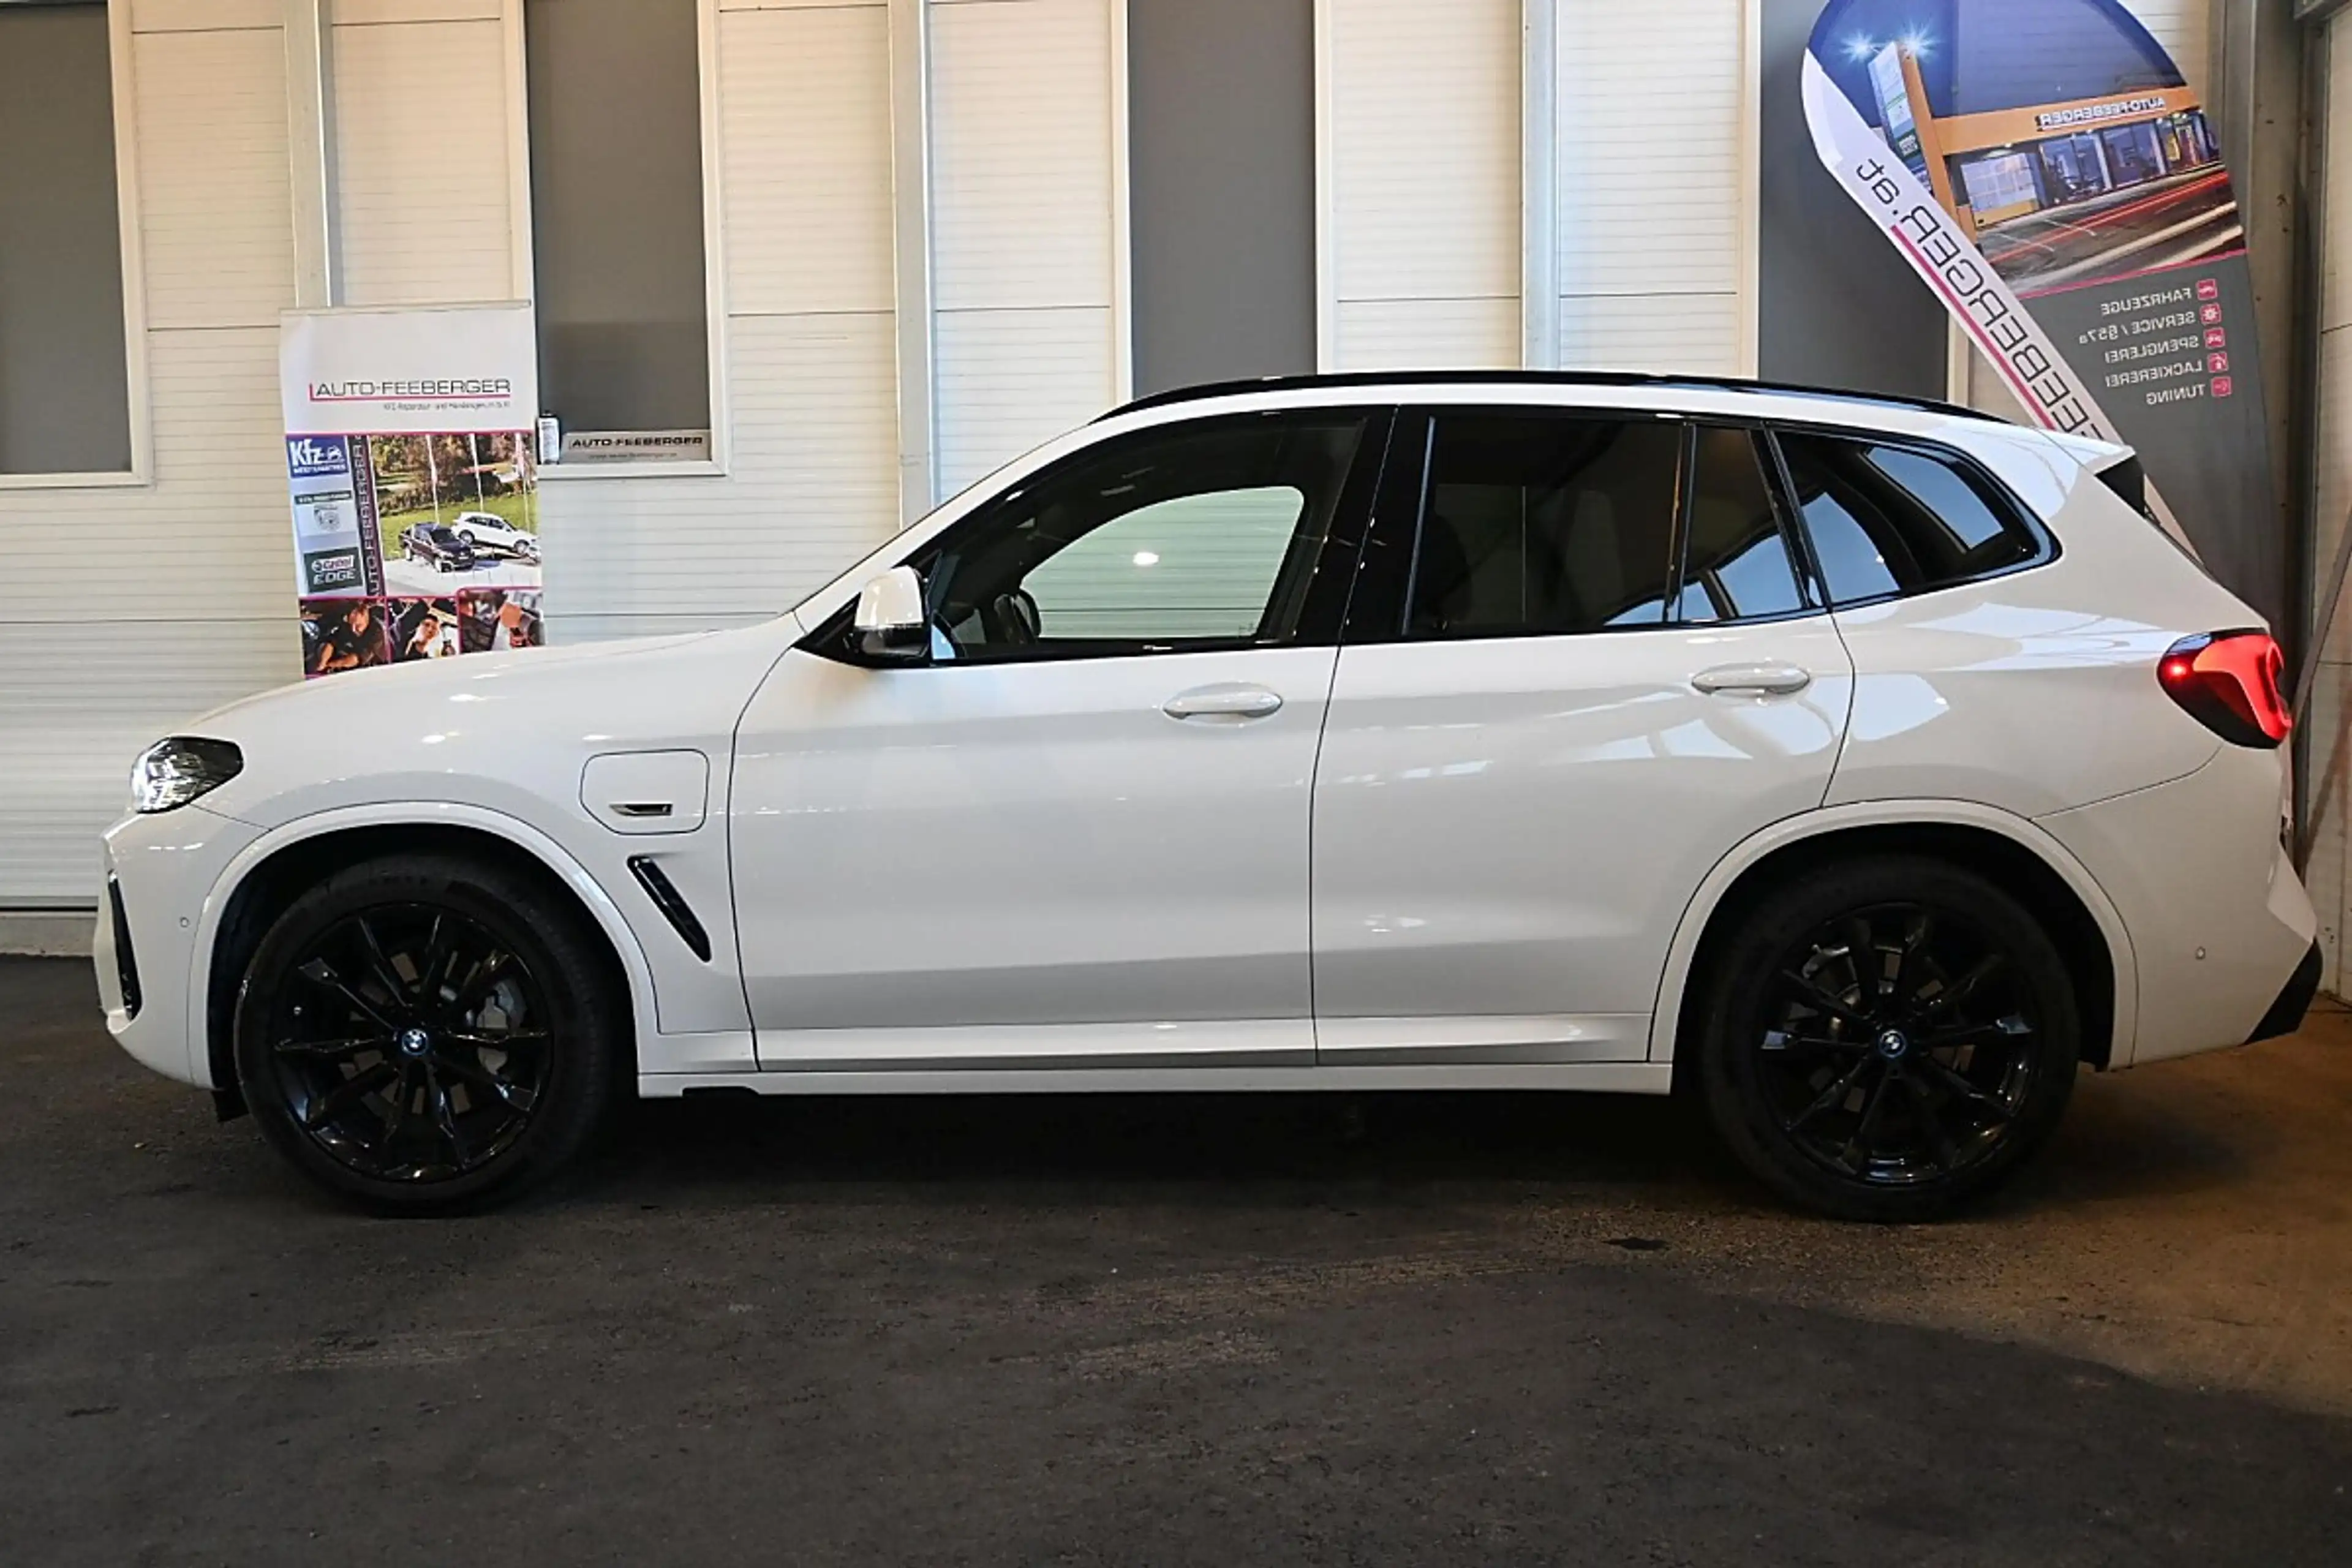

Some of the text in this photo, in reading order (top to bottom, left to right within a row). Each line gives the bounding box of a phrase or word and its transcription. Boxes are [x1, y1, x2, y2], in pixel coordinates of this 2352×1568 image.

[315, 379, 511, 397] AUTO-FEEBERGER
[289, 439, 323, 467] Kfz
[313, 569, 356, 585] EDGE
